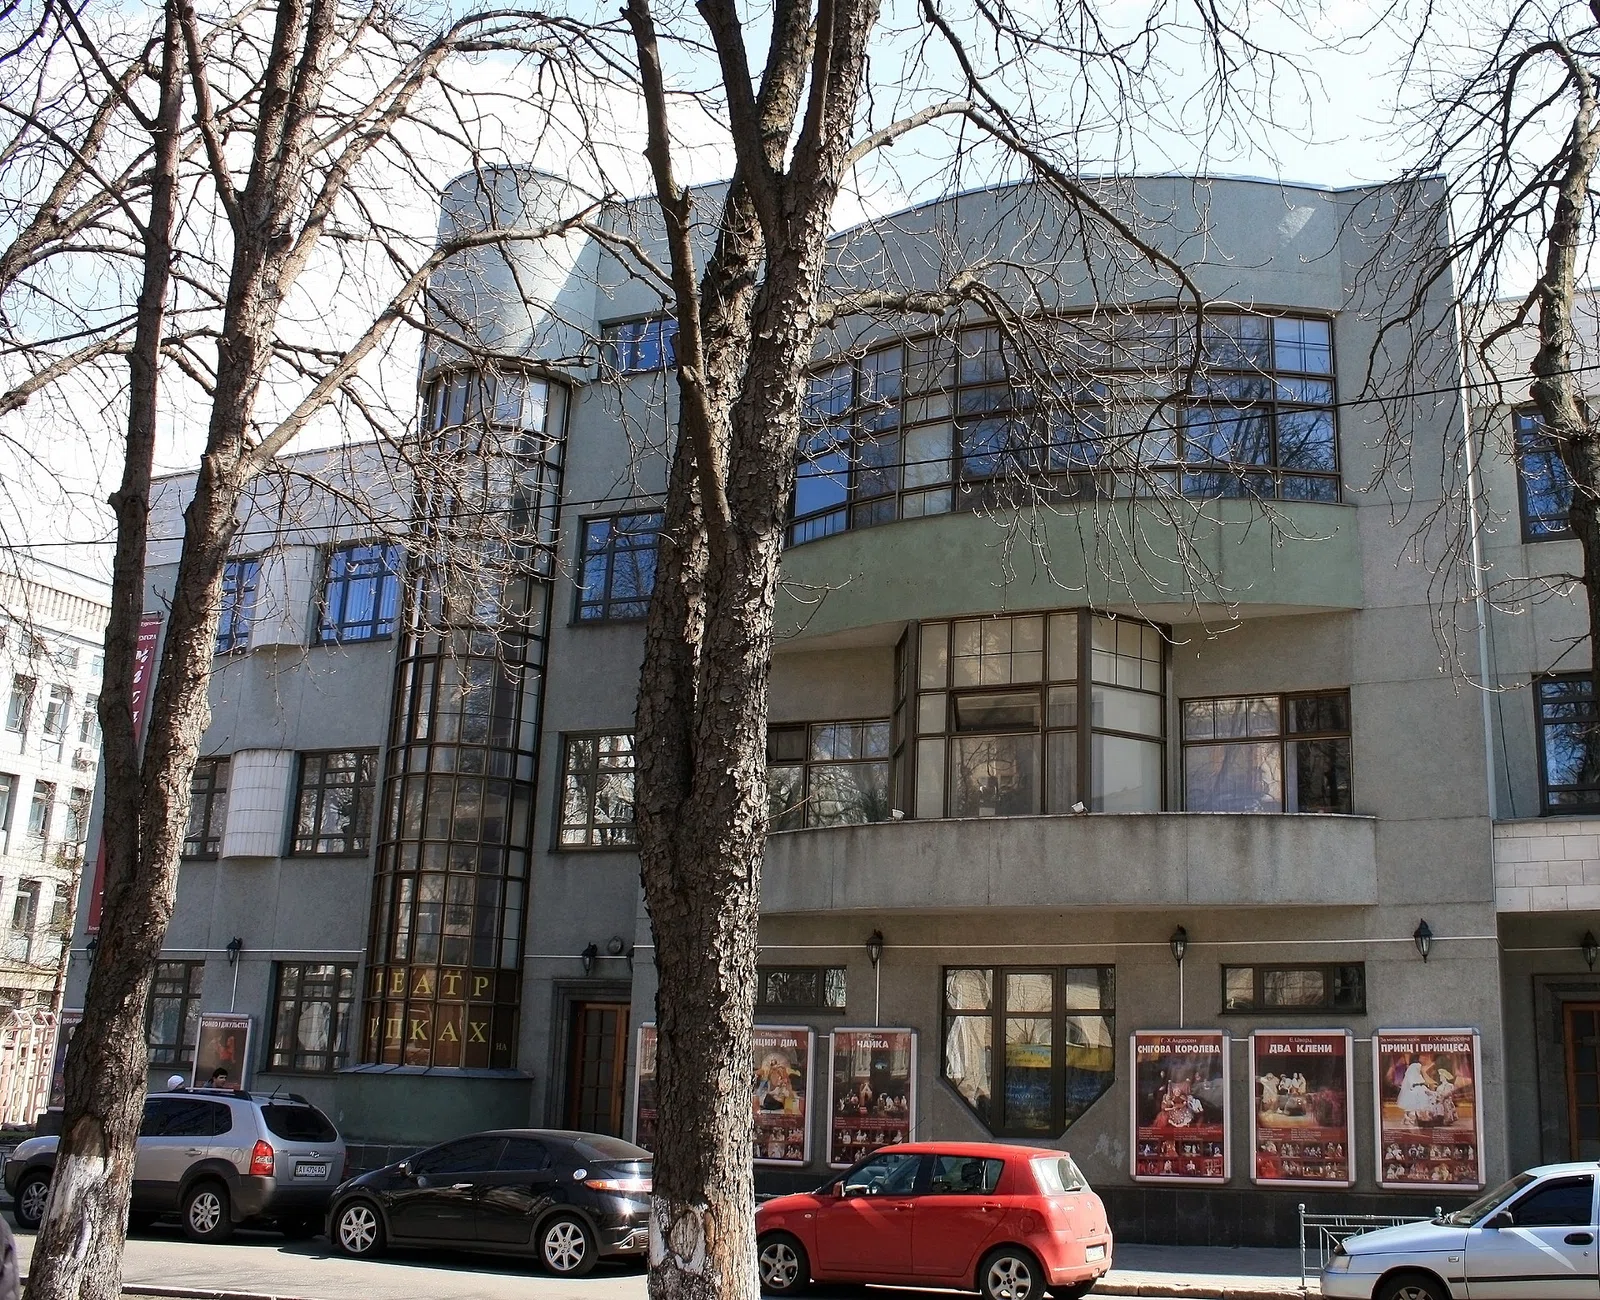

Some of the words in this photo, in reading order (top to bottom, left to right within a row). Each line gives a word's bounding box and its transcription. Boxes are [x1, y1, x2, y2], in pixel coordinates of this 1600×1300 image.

[376, 972, 489, 997] ТЕАТР
[370, 1016, 487, 1043] ИПКАХ
[753, 1038, 777, 1048] ИЦИН
[780, 1038, 798, 1048] ДІМ
[857, 1038, 889, 1049] ЧАЙКА
[1381, 1043, 1414, 1054] ПРИНЦ
[1415, 1043, 1419, 1053] І
[1420, 1043, 1471, 1054] ПРИНЦЕСА
[1137, 1044, 1171, 1054] СНІГОВА
[1175, 1044, 1220, 1054] КОРОЛЕВА
[1269, 1044, 1292, 1054] ДВА
[1296, 1044, 1333, 1053] КЛЕНИ
